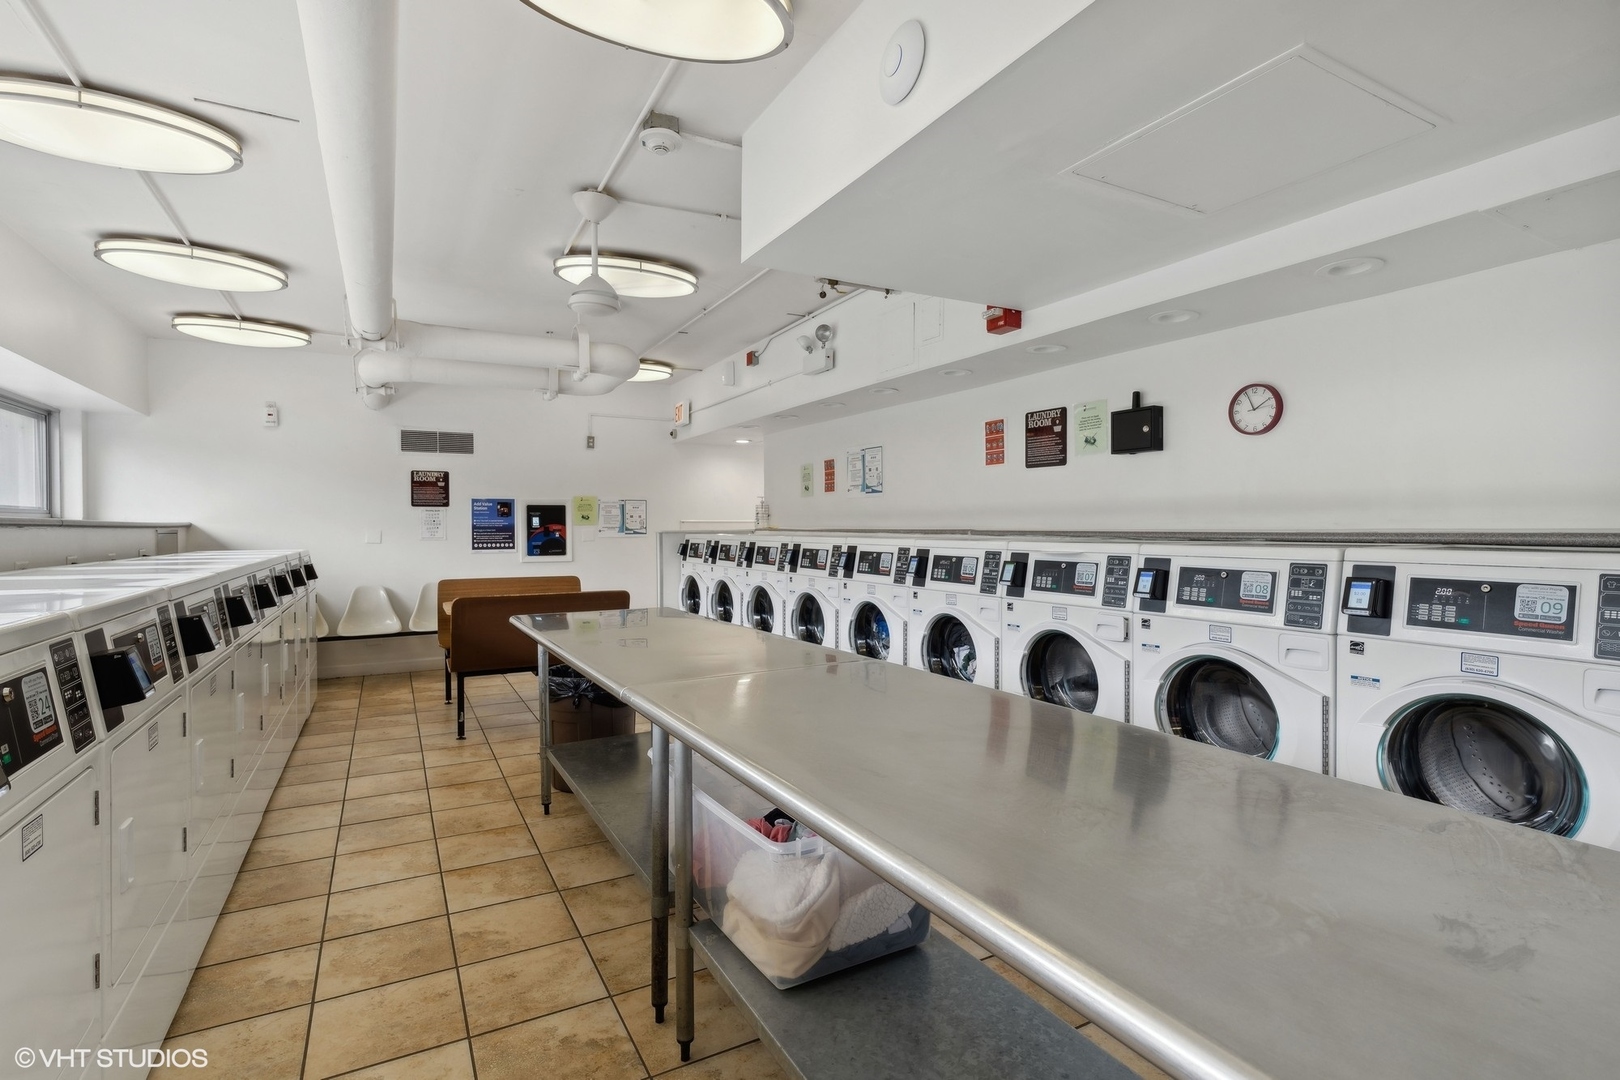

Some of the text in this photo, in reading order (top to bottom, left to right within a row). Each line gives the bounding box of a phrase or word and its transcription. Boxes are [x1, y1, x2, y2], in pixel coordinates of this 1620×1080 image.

[1027, 409, 1062, 420] LAUNDRY
[1027, 418, 1052, 428] ROOM
[1084, 573, 1094, 581] 07
[1254, 584, 1268, 594] 08
[1540, 602, 1563, 614] 09
[38, 696, 51, 716] 24
